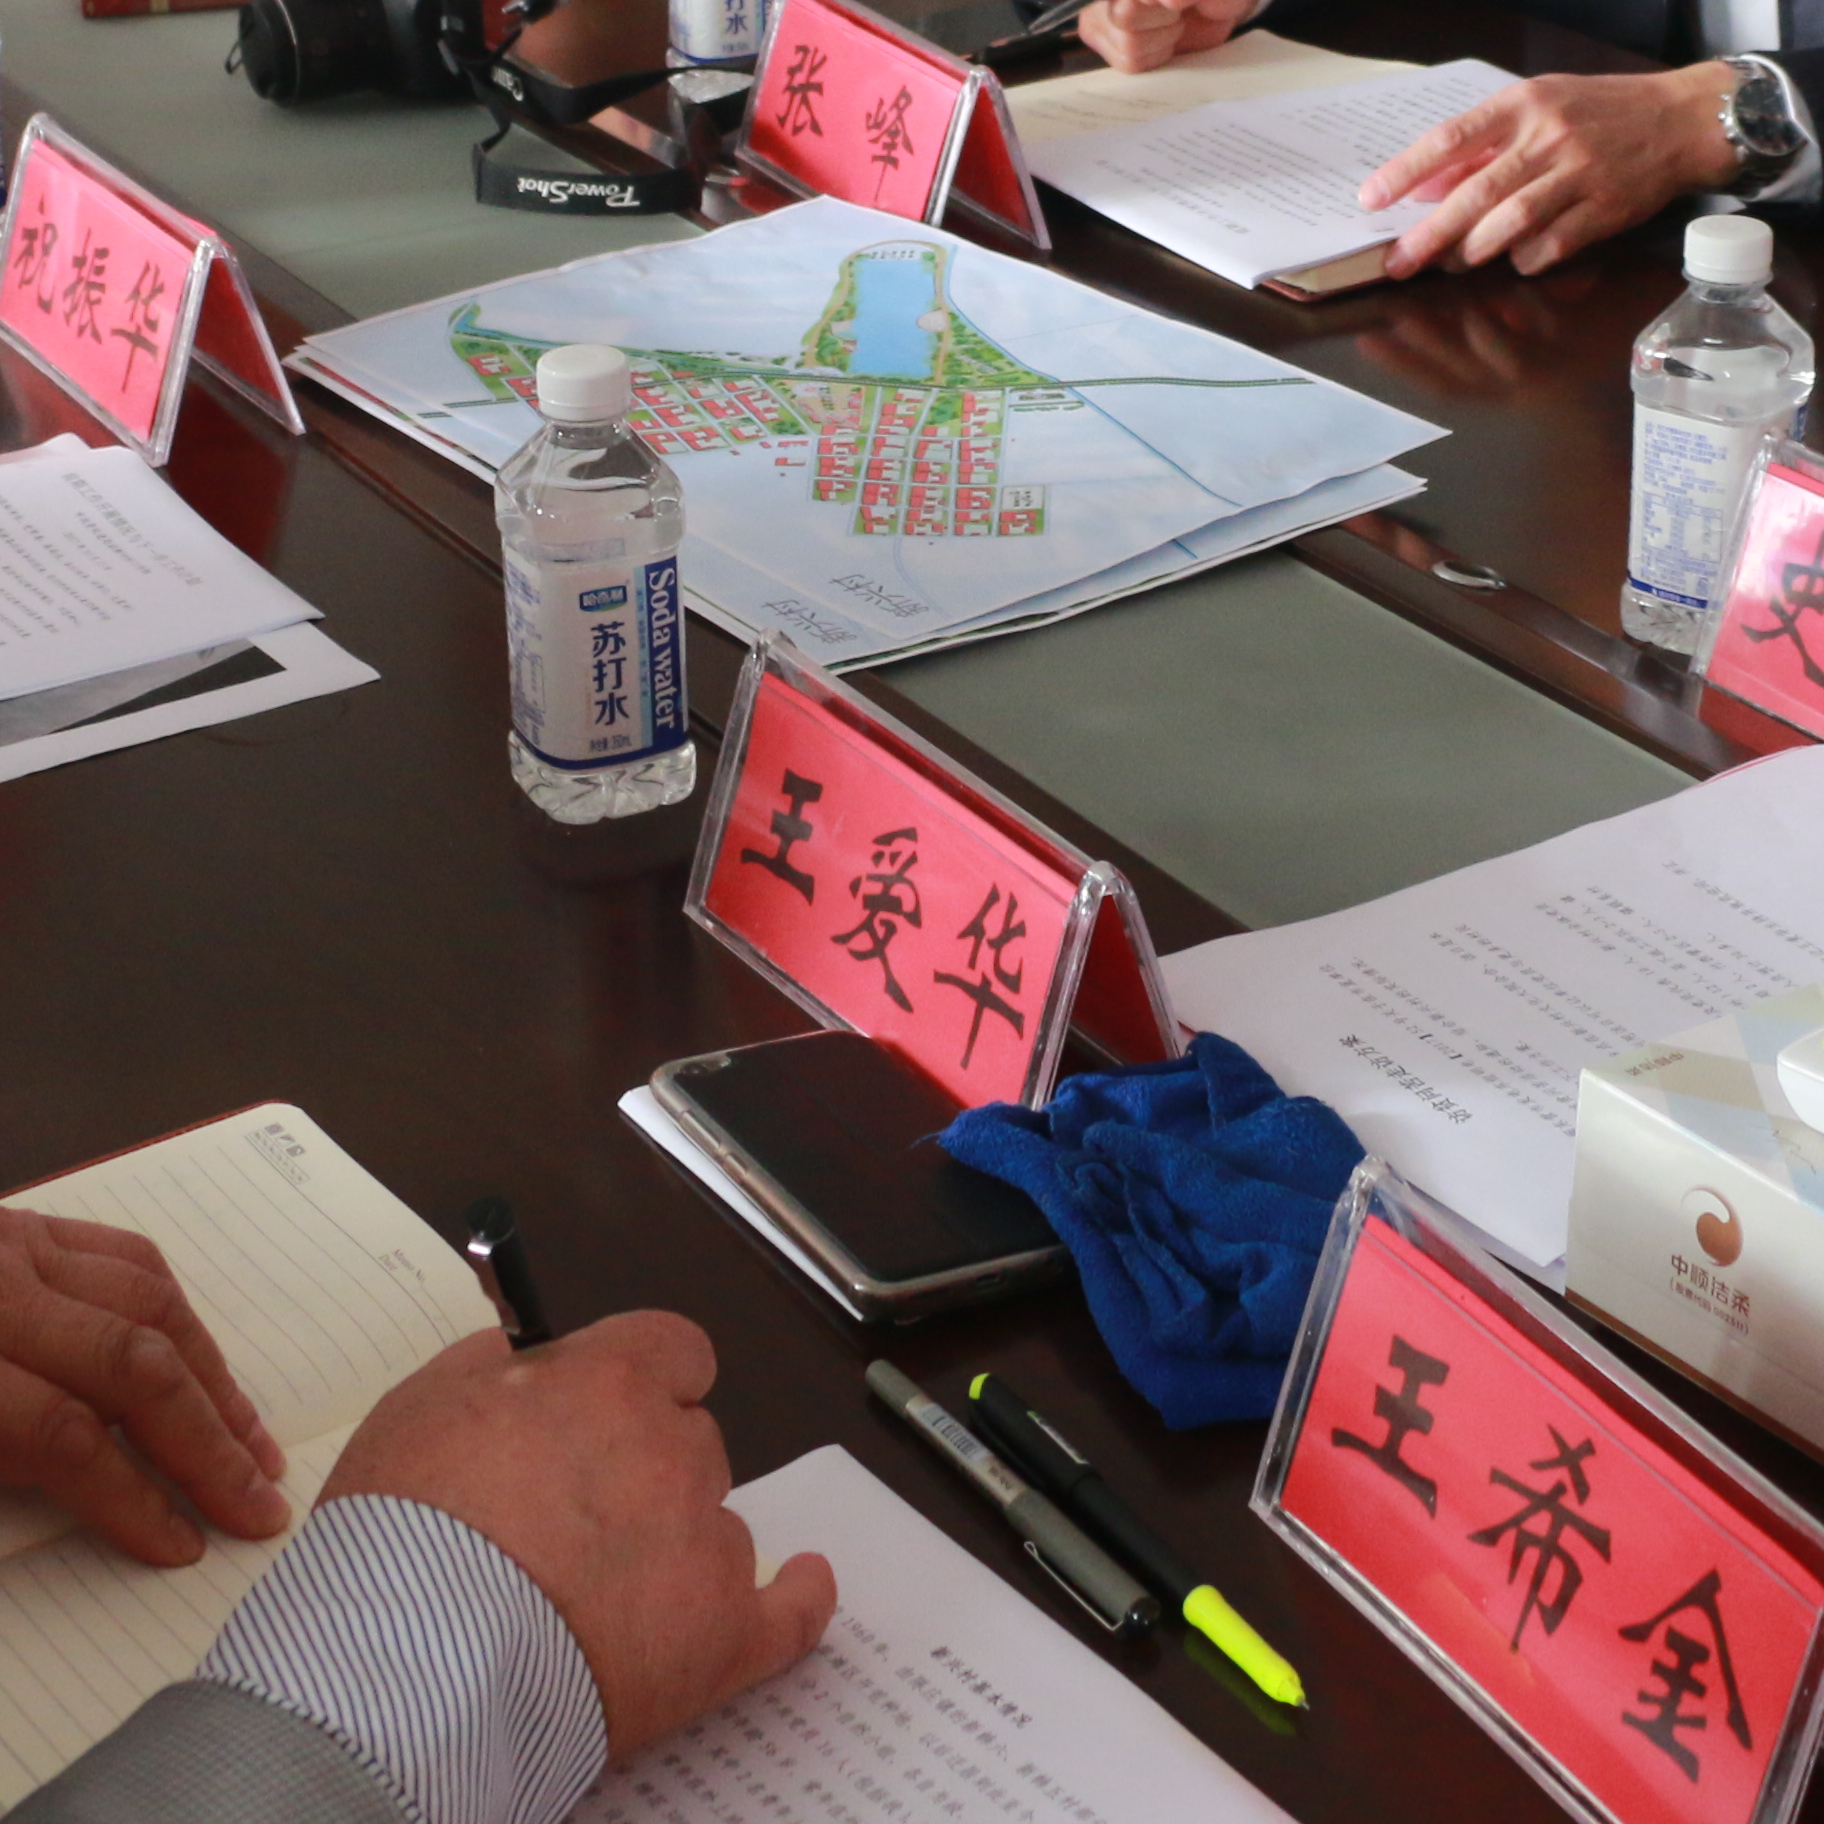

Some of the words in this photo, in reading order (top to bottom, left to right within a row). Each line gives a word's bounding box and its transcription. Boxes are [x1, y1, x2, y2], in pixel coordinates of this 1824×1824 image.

[776, 44, 914, 202] 张峰
[517, 176, 641, 208] PowerShot
[13, 192, 164, 393] 祝振华
[648, 567, 675, 646] Soda
[591, 622, 629, 725] 苏打水
[653, 647, 675, 729] water
[740, 767, 1028, 1071] 王爱华
[1671, 1254, 1750, 1318] 中顺洁柔
[1330, 1333, 1753, 1784] 王希全
